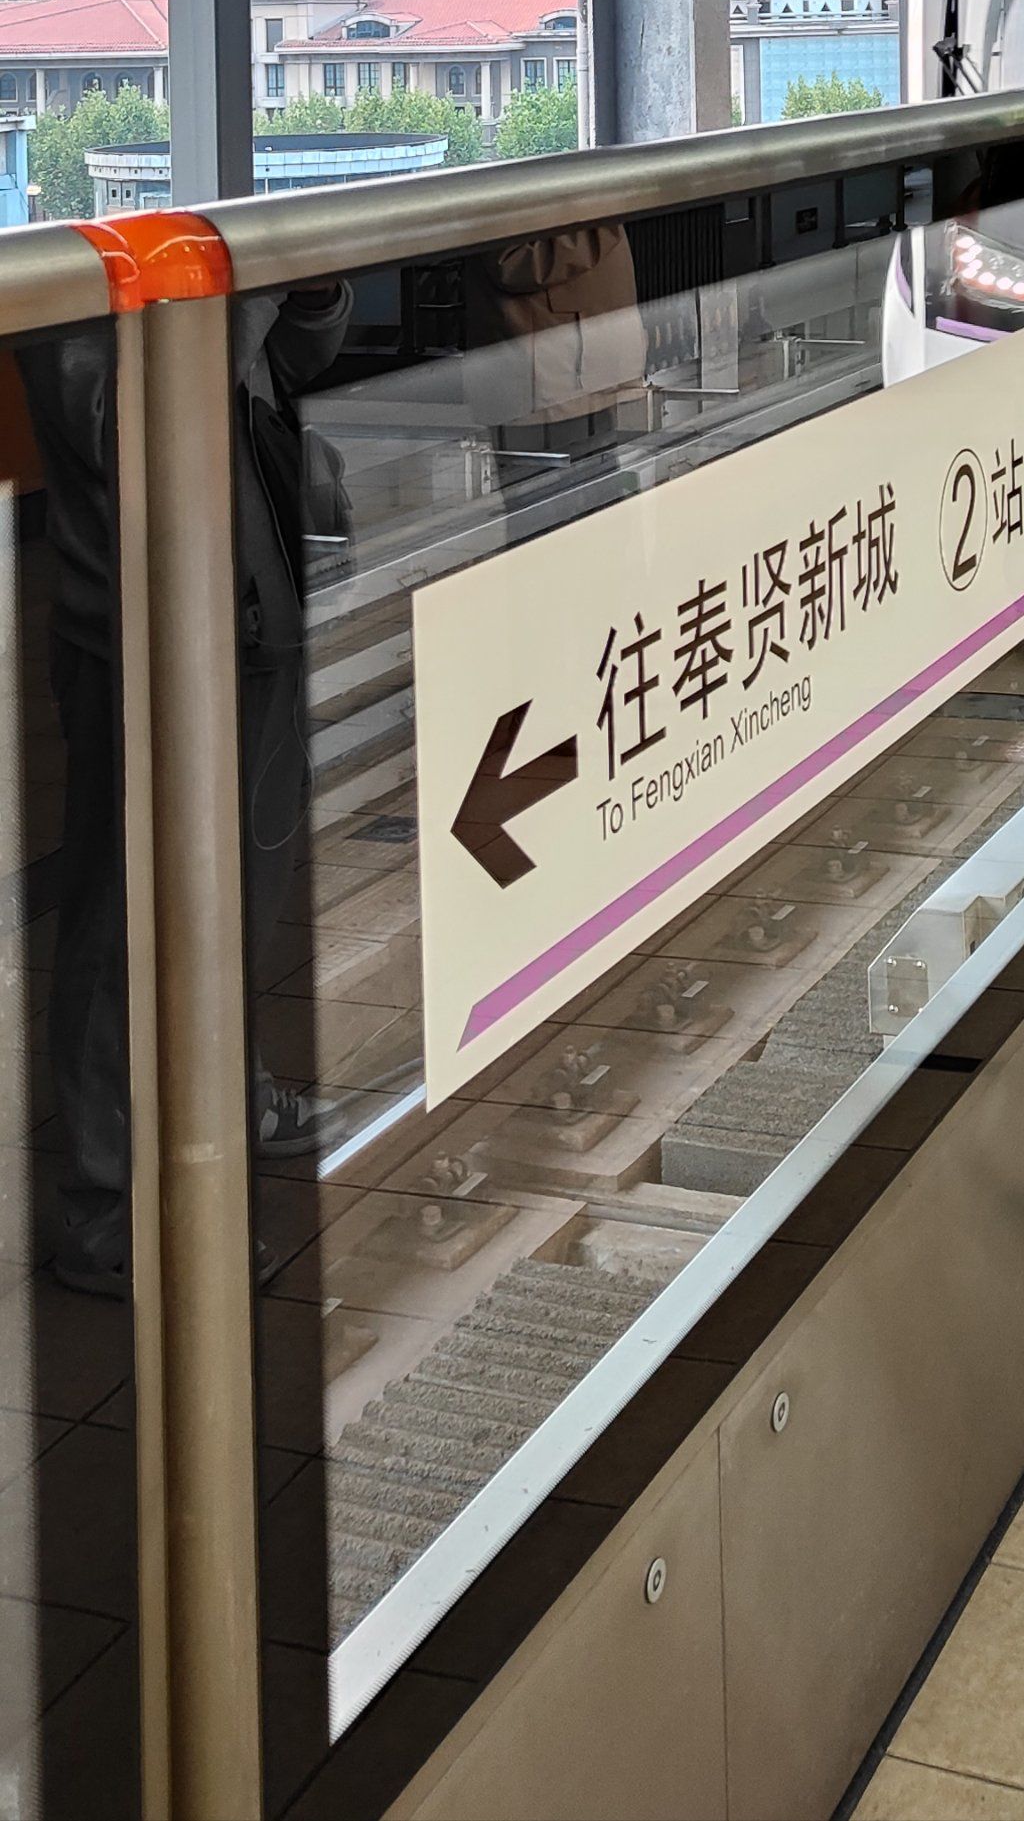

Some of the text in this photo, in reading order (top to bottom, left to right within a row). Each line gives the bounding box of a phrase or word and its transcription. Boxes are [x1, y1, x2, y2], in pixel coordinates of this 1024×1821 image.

[596, 482, 899, 781] 往奉贤新城
[596, 674, 812, 841] To Fengxian Xincheng
